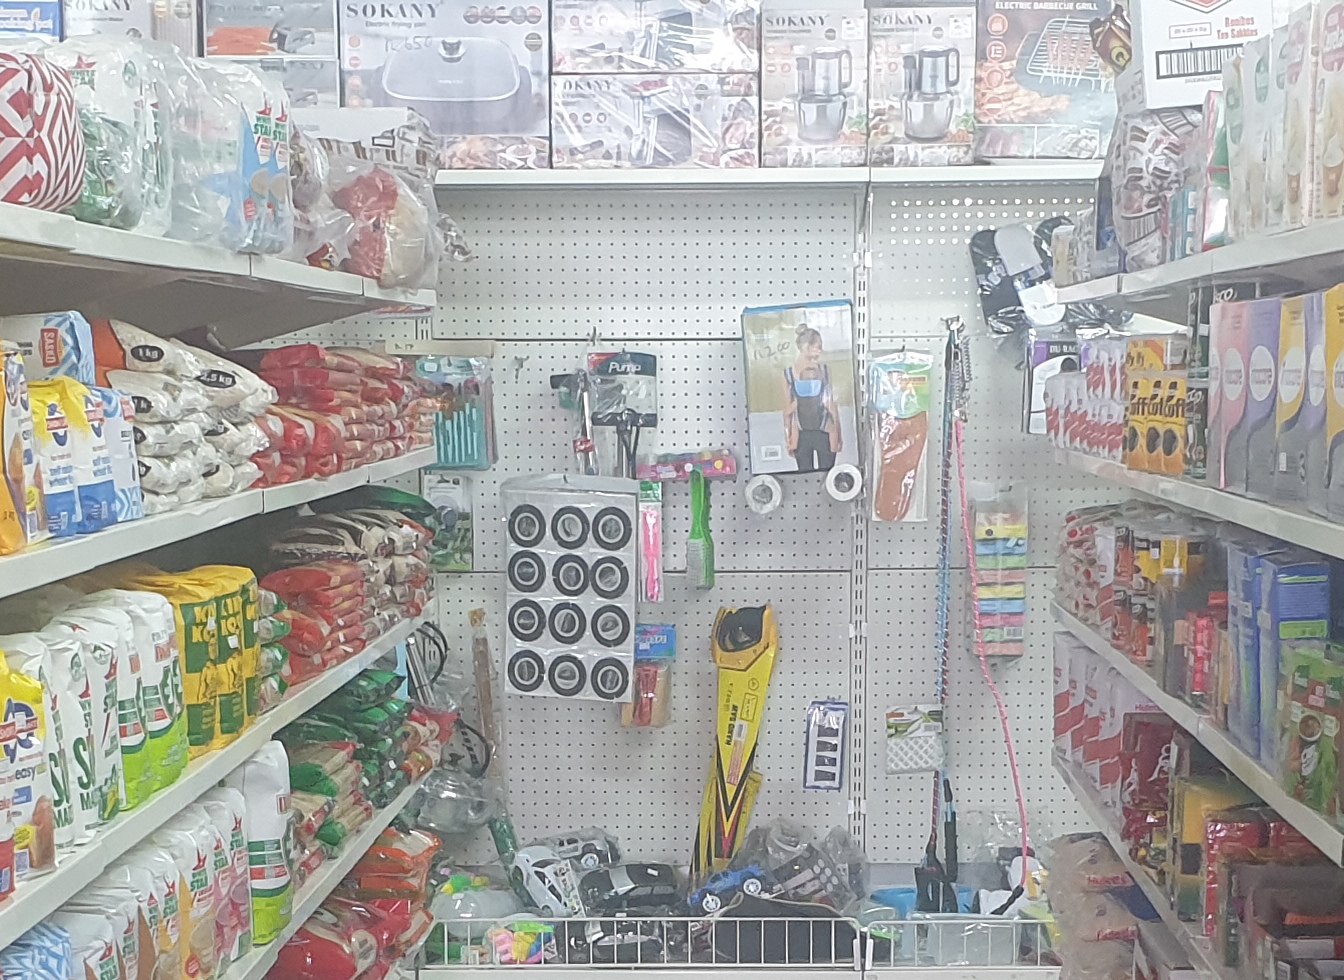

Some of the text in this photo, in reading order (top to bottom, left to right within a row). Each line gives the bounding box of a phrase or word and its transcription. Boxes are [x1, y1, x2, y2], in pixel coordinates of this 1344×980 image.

[346, 3, 440, 19] SOKANY
[765, 15, 827, 27] SOKANY
[872, 14, 934, 26] SOKANY
[145, 348, 159, 359] kg
[608, 361, 642, 374] Pump
[218, 373, 233, 386] kg
[15, 766, 36, 781] easy
